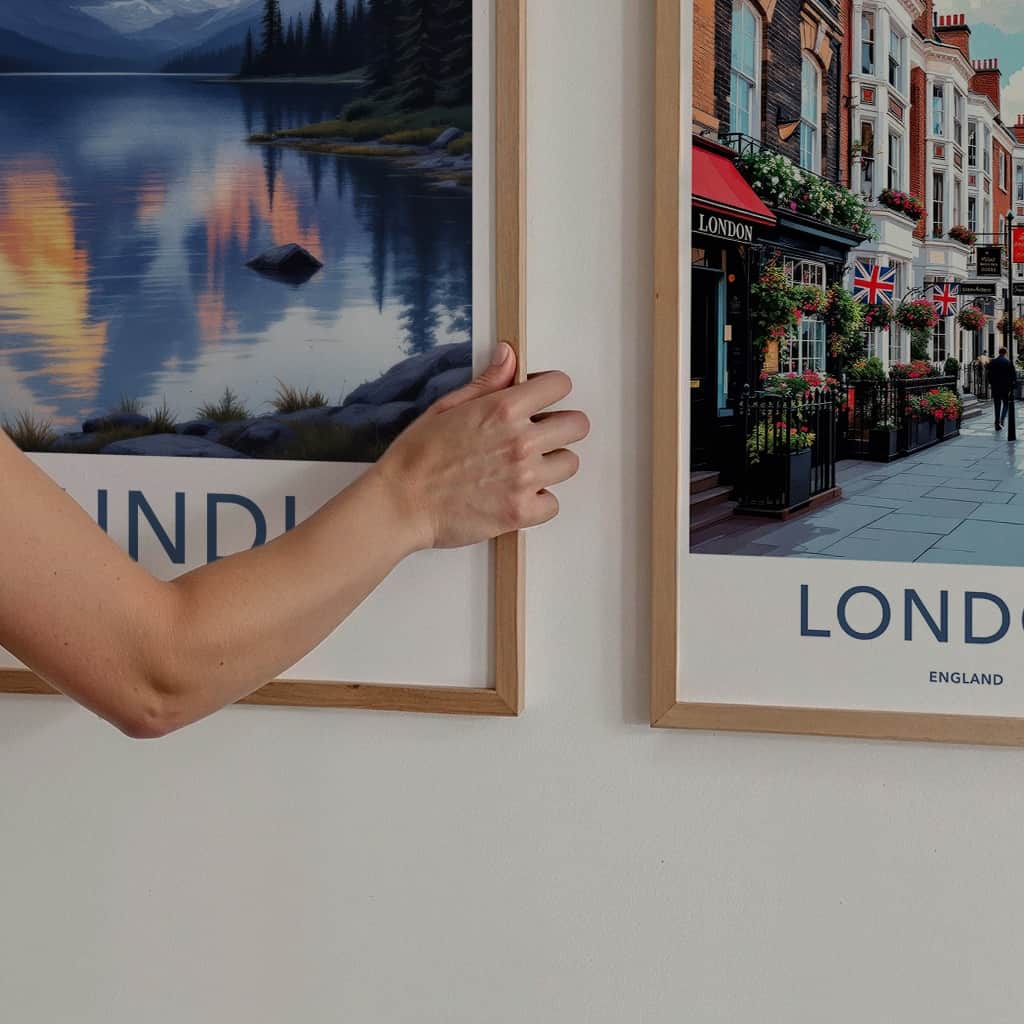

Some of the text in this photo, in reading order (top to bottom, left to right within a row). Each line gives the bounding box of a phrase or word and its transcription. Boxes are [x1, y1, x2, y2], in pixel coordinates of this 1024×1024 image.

[698, 213, 753, 241] LONDON
[799, 584, 1024, 645] LOND
[928, 671, 1005, 686] ENGLAND
